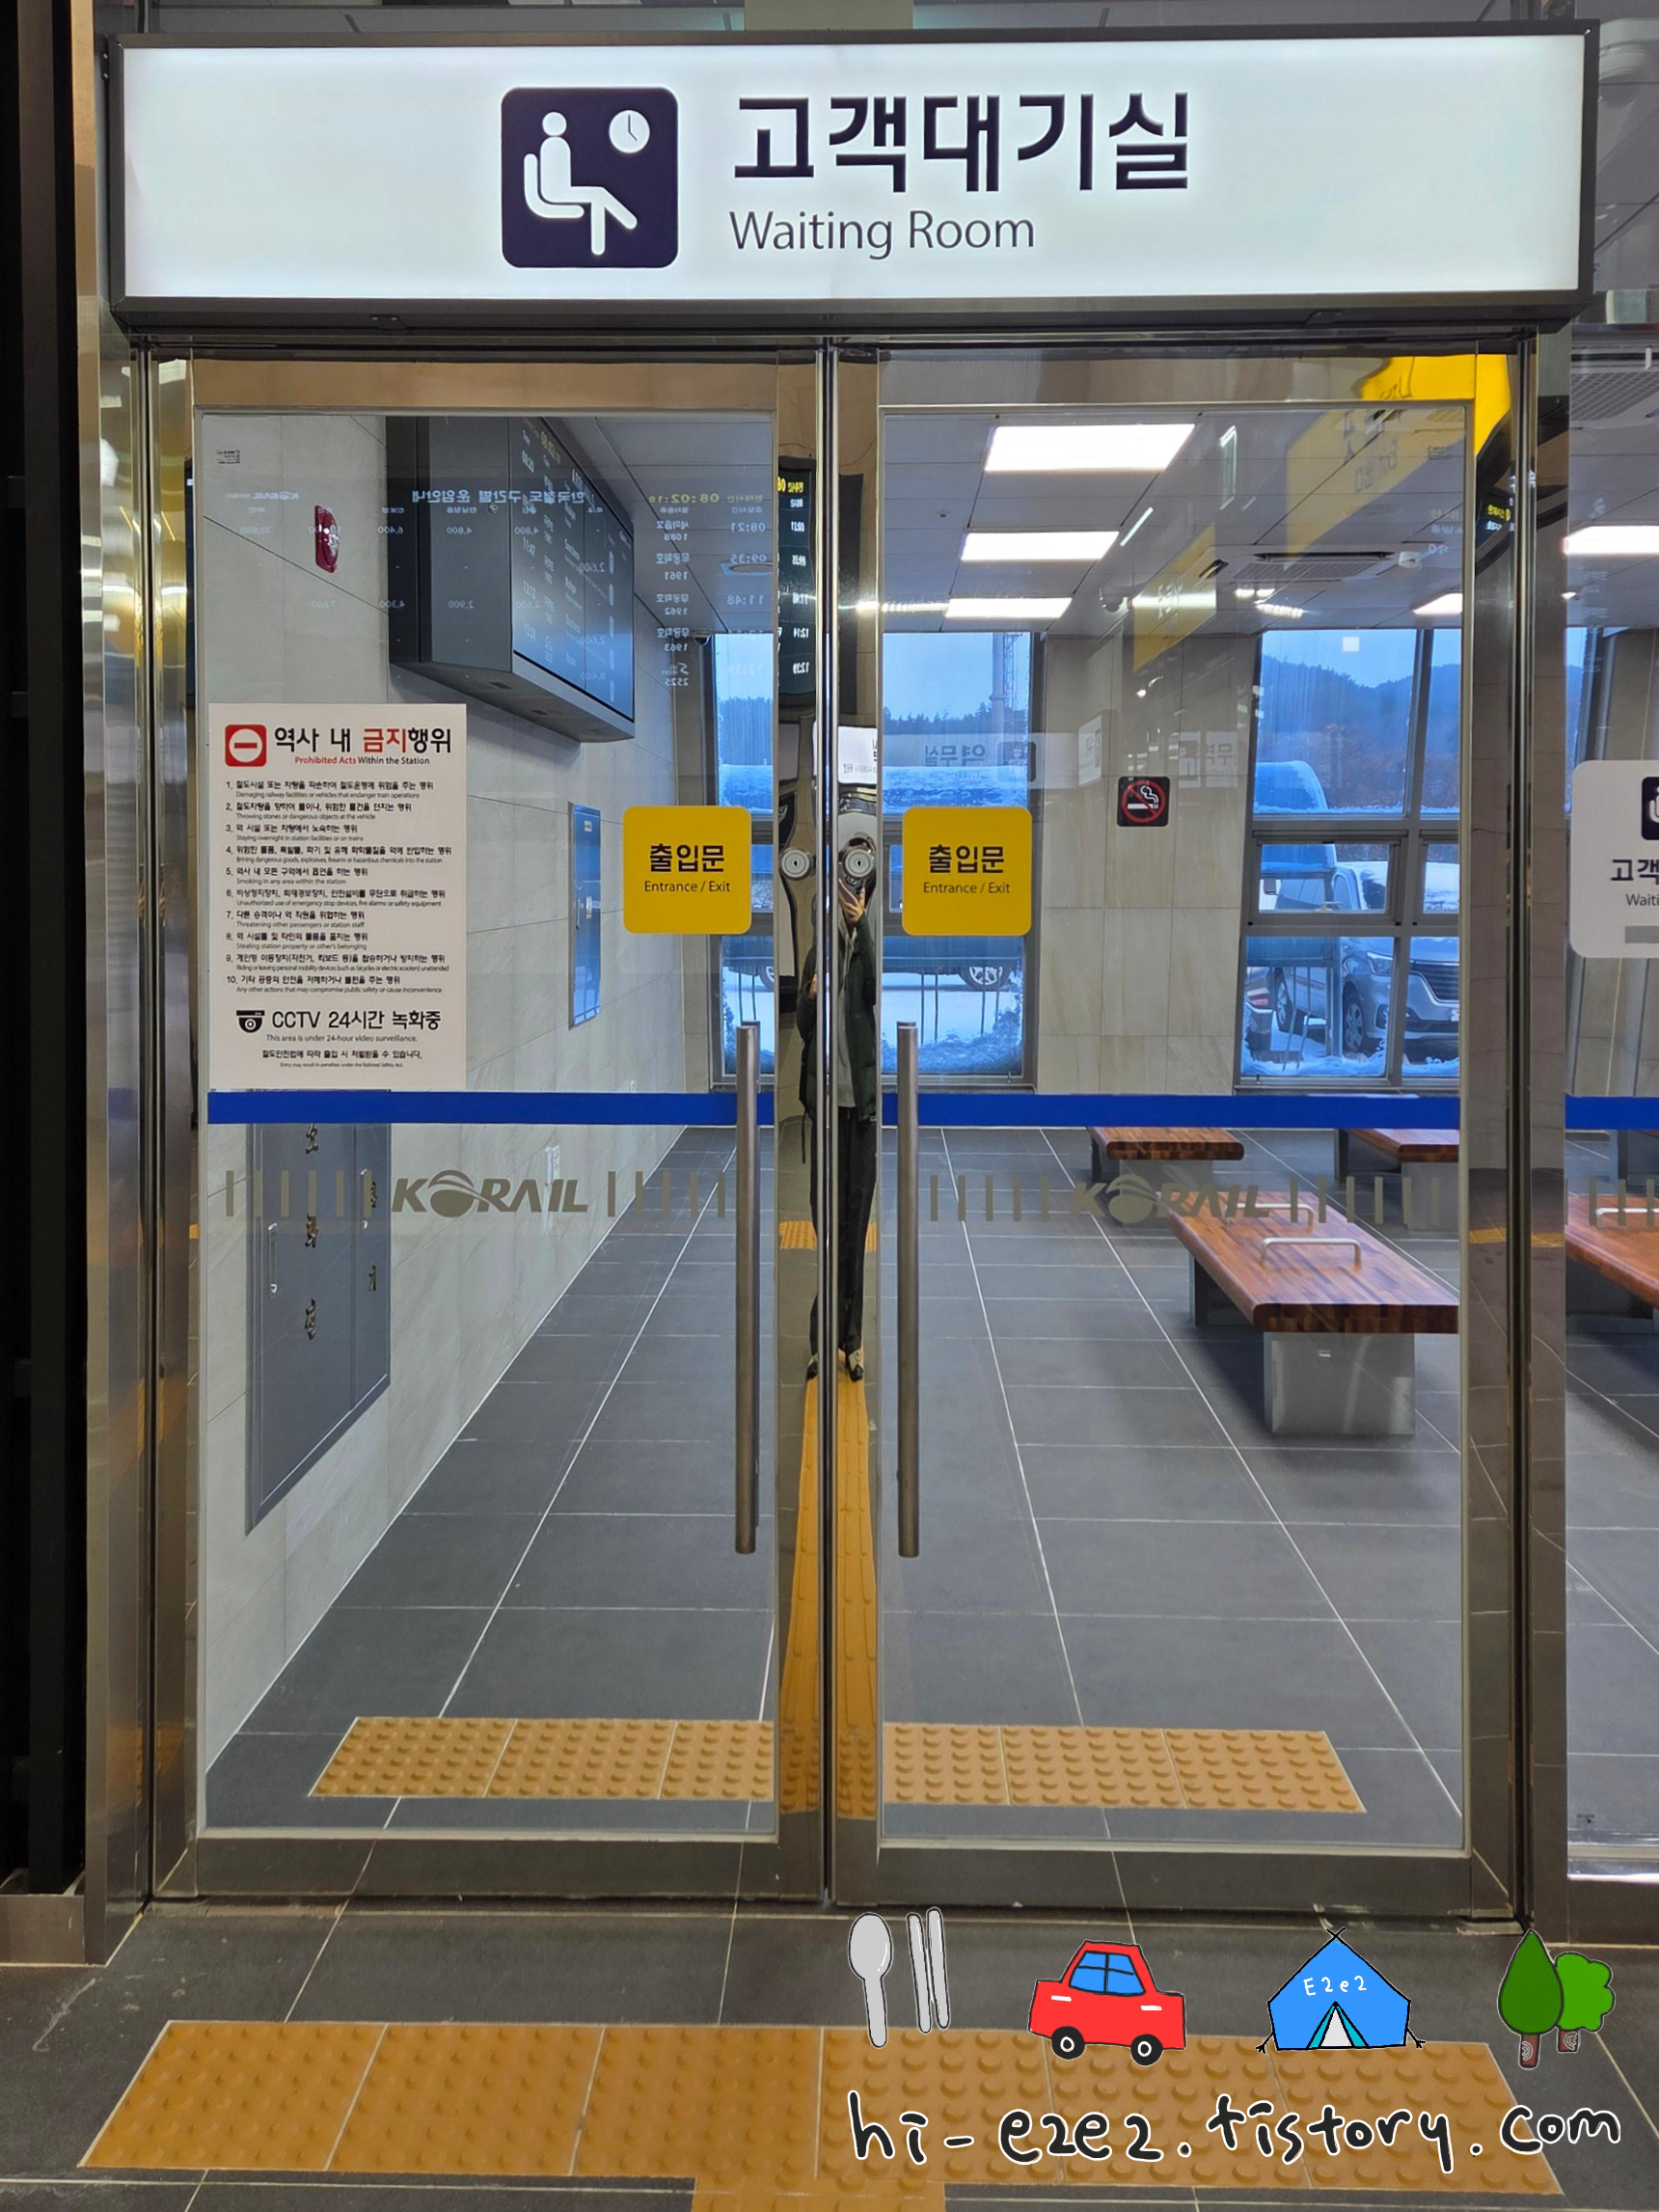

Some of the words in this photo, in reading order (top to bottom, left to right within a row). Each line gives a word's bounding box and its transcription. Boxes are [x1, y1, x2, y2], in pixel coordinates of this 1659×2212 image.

[733, 92, 1188, 193] 고객대기실
[729, 210, 892, 260] Waiting
[910, 210, 1034, 251] Room
[274, 727, 319, 752] 역사
[331, 727, 351, 752] 내
[364, 727, 451, 752] 금지행위
[649, 844, 725, 873] 출입문
[928, 845, 1005, 874] 출입문
[644, 881, 697, 893] Entrance
[709, 881, 731, 893] Exit
[924, 882, 977, 894] Entrance
[988, 882, 1011, 894] Exit
[272, 1011, 320, 1028] CCTV
[328, 1010, 386, 1030] 24시간
[392, 1009, 442, 1030] 녹화중
[393, 1169, 588, 1217] KORAIL
[1071, 1174, 1269, 1224] KORAIL
